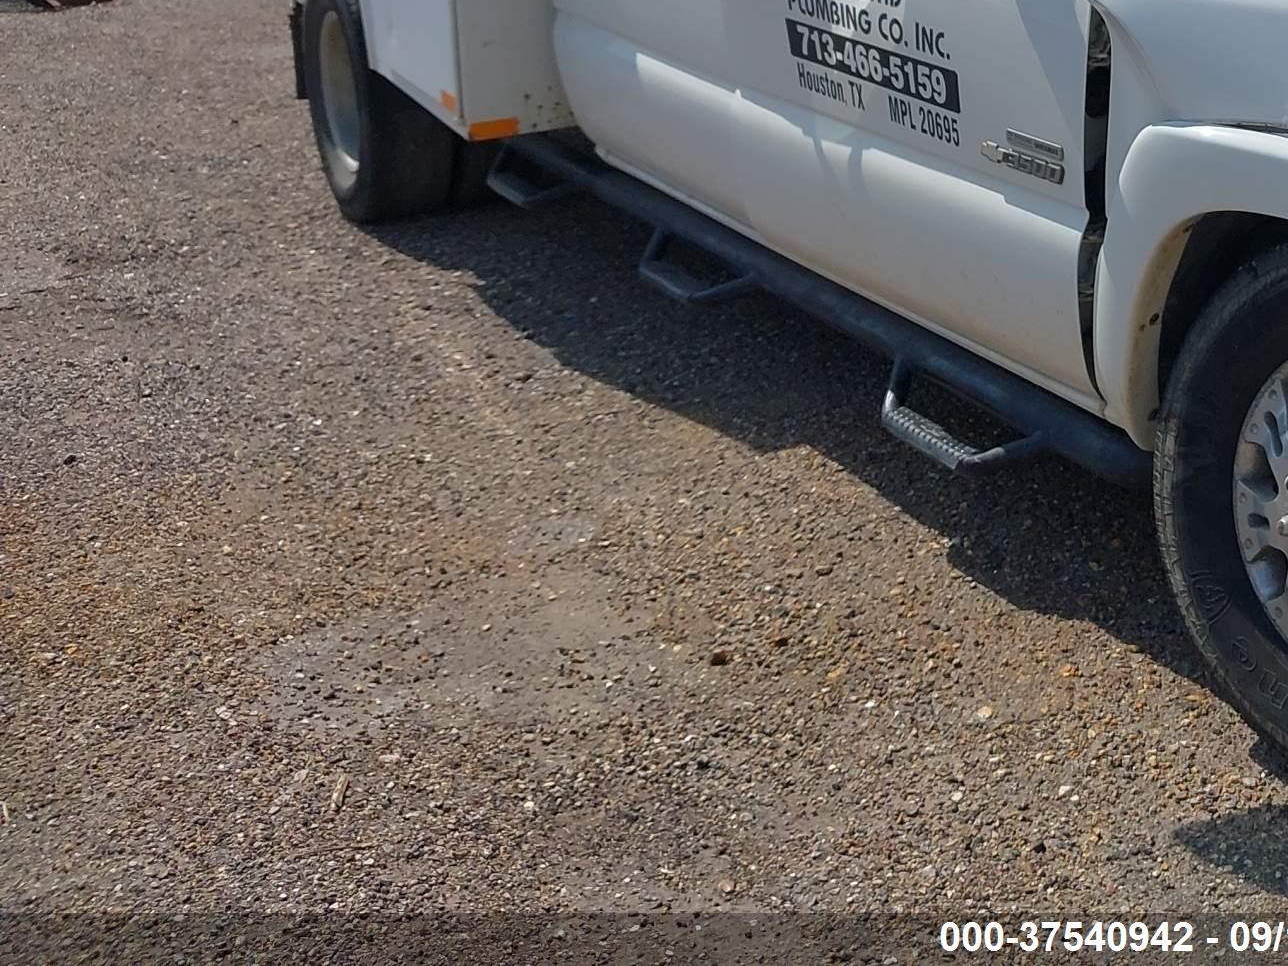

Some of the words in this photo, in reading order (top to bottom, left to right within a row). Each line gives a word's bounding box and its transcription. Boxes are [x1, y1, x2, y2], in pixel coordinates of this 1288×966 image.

[878, 13, 908, 48] CO.
[915, 20, 951, 60] INC.
[796, 24, 947, 105] 713-466-5159
[797, 62, 847, 107] Houston,
[849, 81, 865, 111] TX
[888, 95, 916, 130] MPL
[919, 107, 960, 147] 20695
